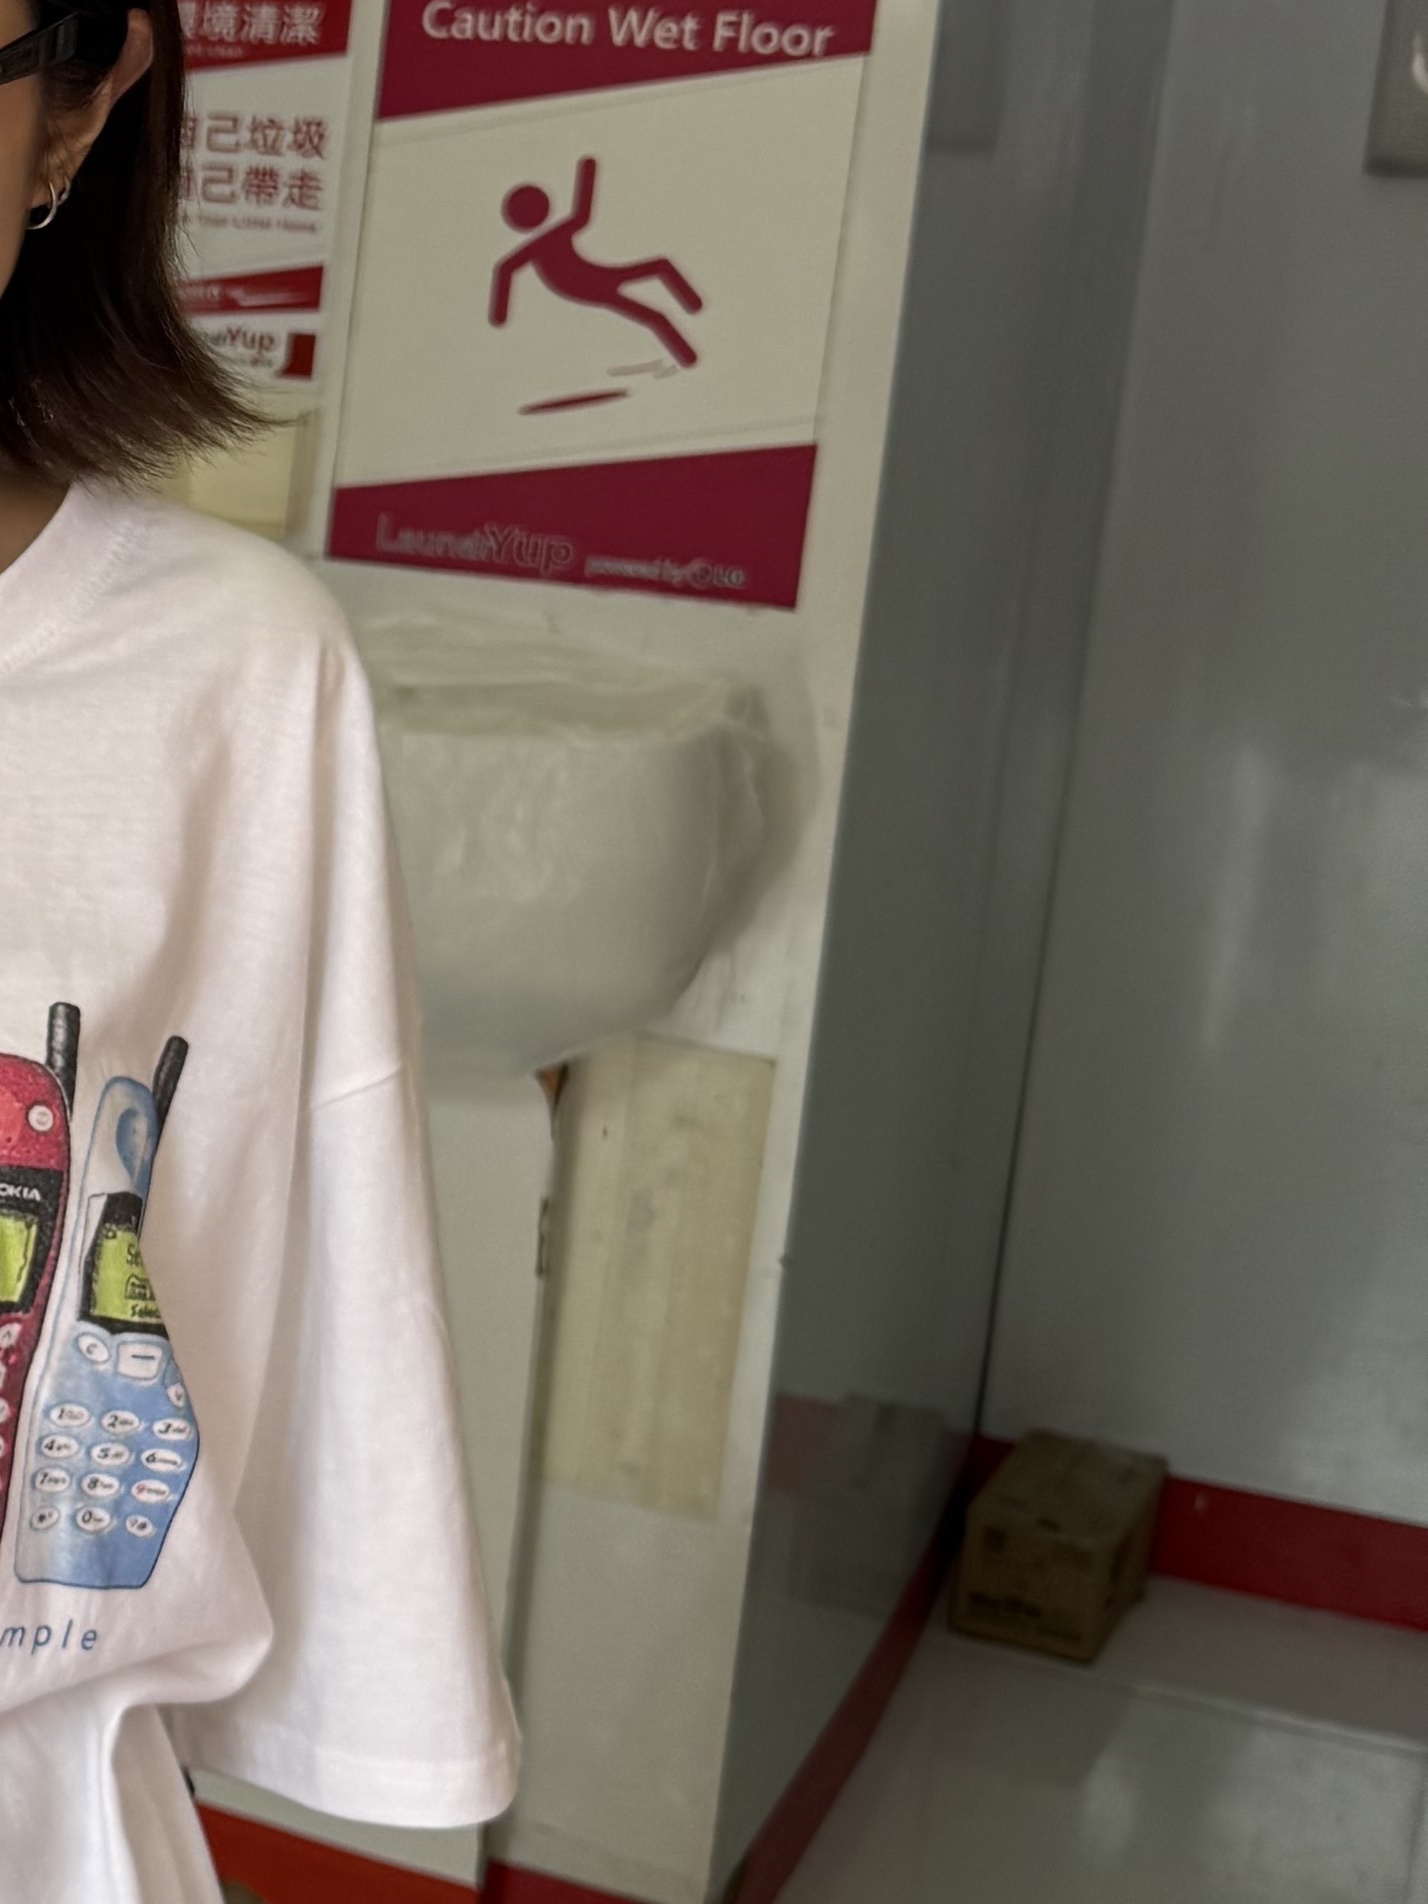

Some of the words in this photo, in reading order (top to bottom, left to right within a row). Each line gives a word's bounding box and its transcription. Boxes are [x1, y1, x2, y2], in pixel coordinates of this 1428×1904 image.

[422, 0, 593, 46] Caution
[607, 6, 698, 50] Wet
[713, 12, 836, 57] Floor
